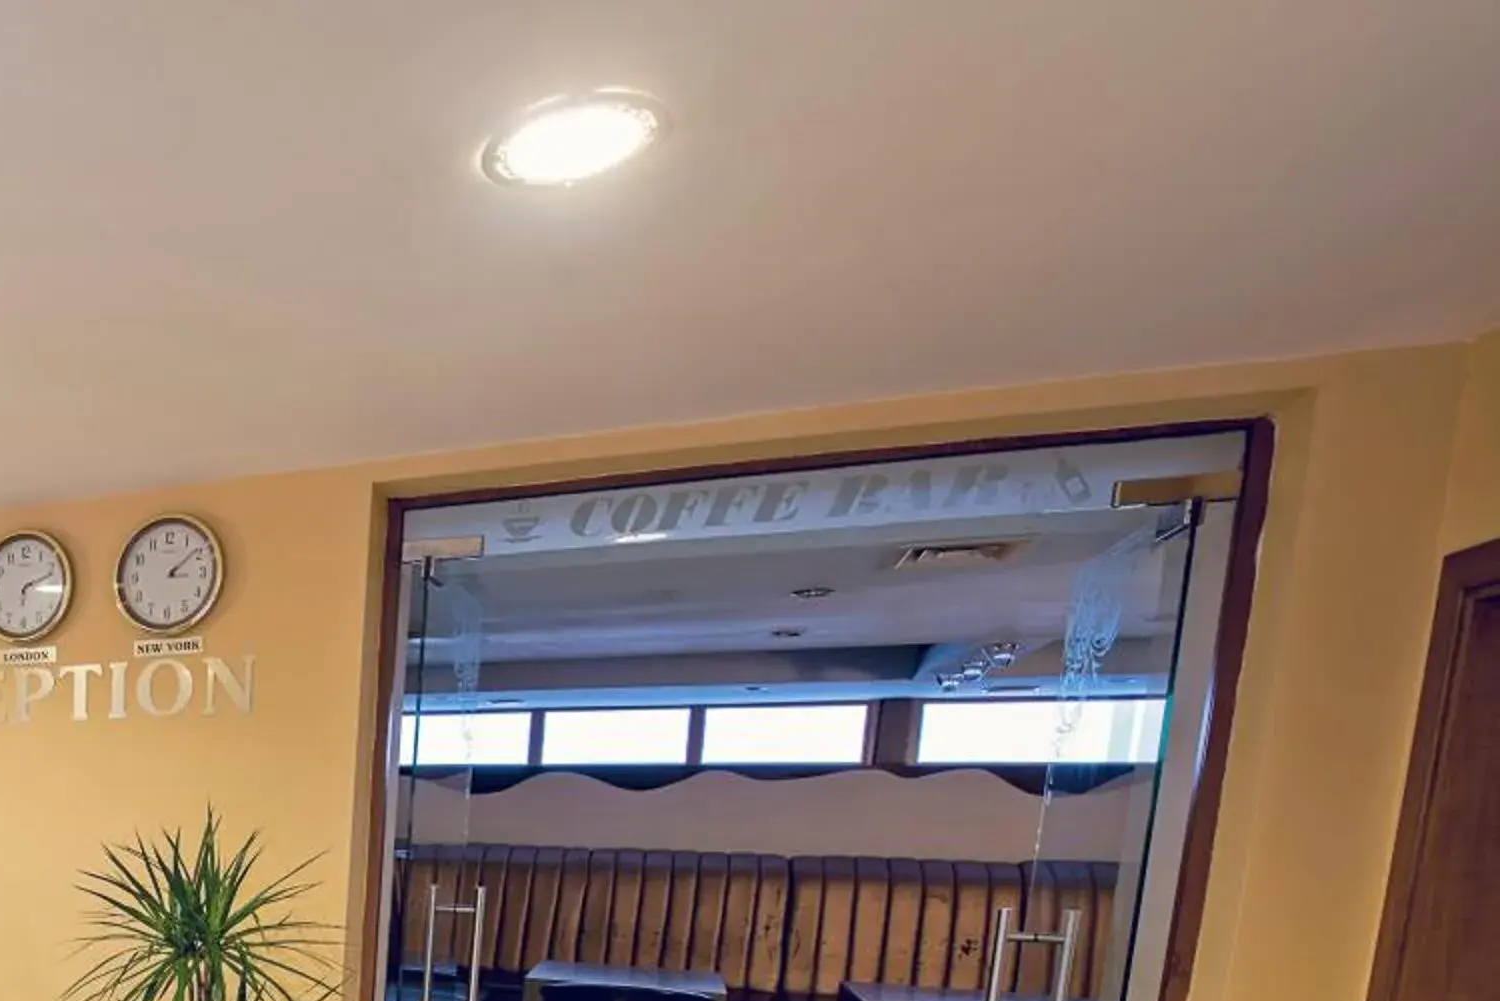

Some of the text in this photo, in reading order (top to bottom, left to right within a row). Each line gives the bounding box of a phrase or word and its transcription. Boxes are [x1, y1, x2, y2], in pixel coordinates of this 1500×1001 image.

[569, 463, 1009, 537] COFFE BAR
[136, 640, 200, 654] NEW YORK
[3, 649, 49, 662] LONDON
